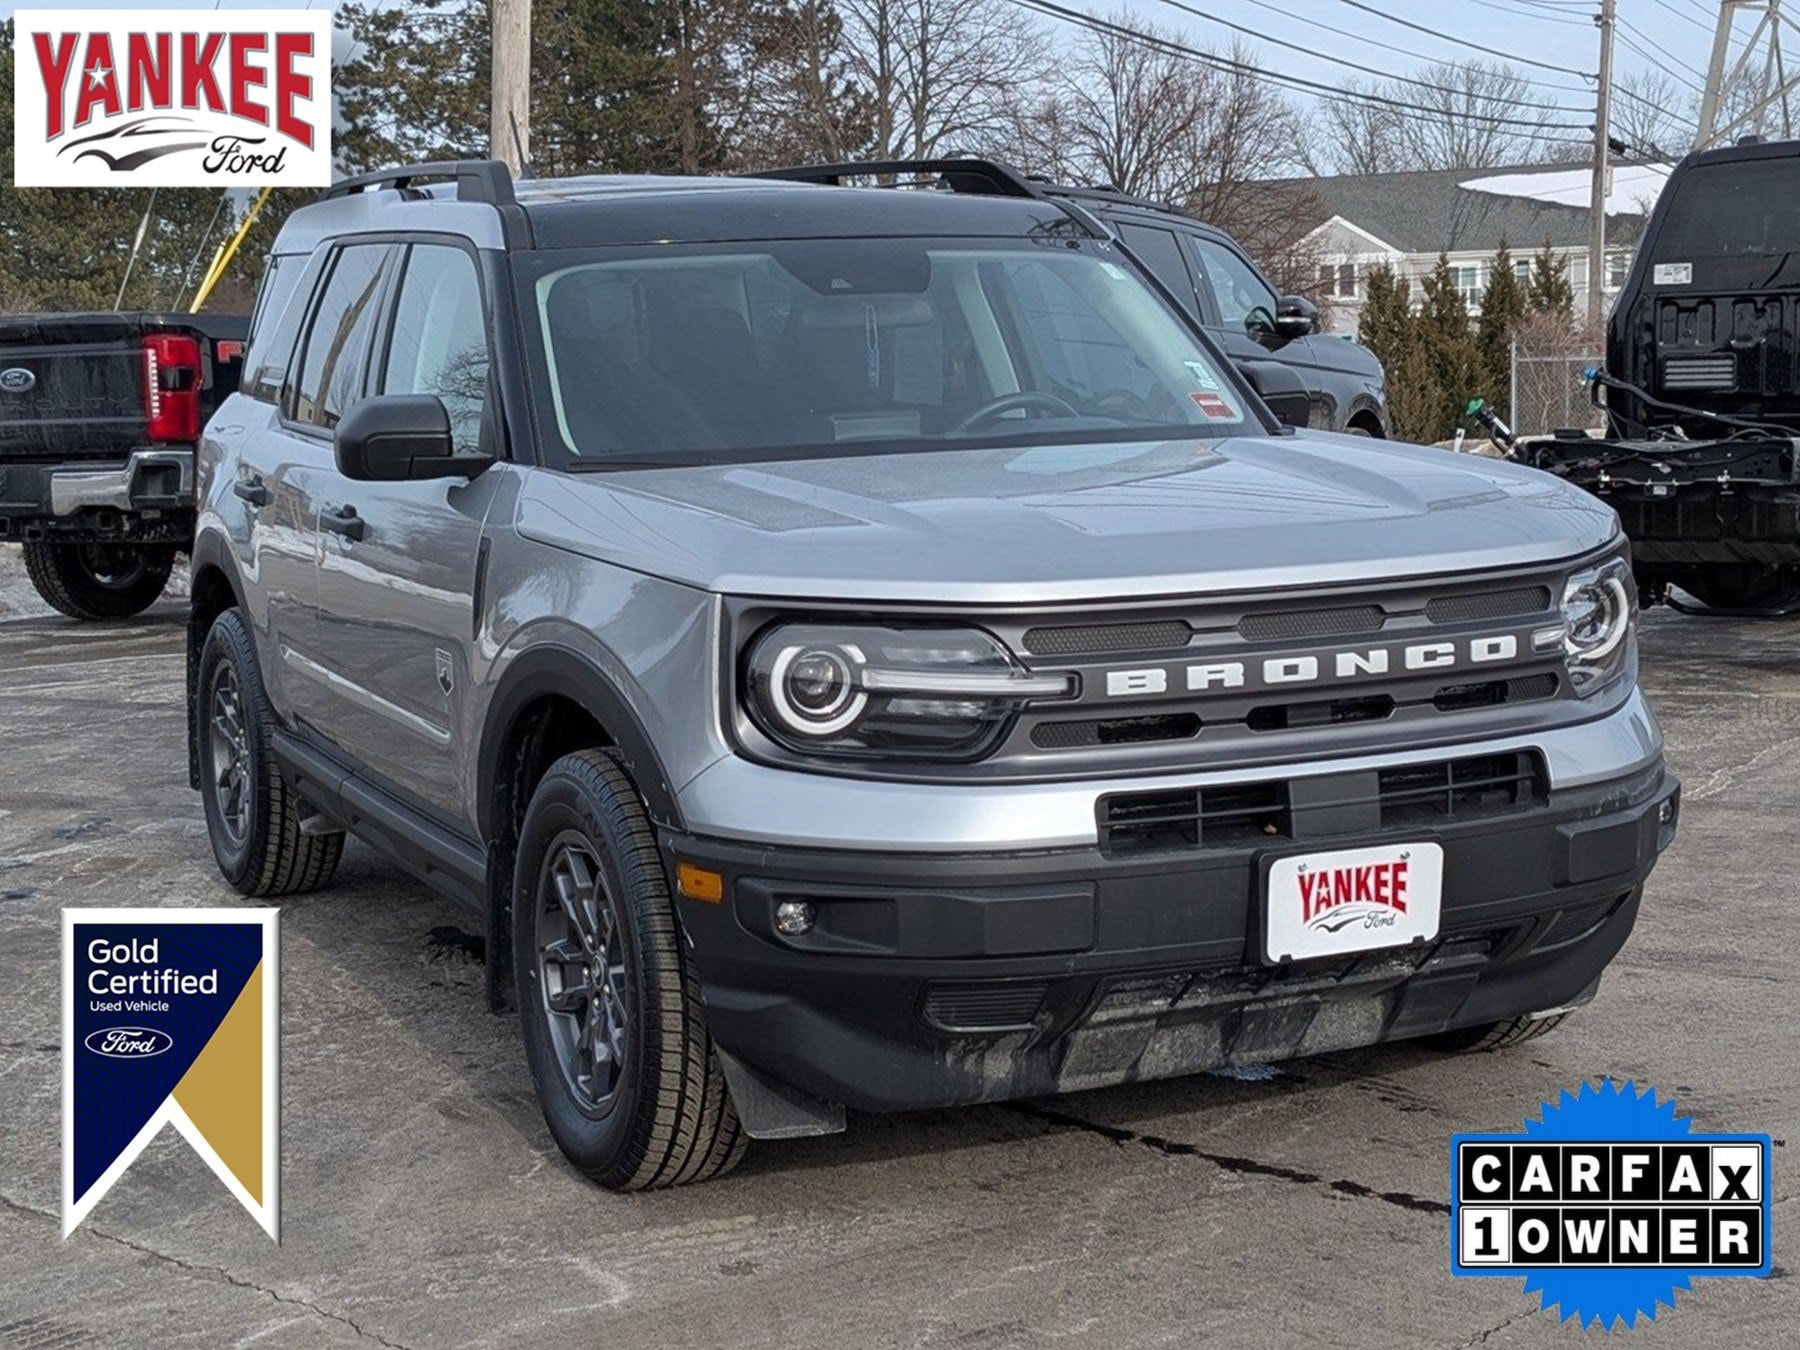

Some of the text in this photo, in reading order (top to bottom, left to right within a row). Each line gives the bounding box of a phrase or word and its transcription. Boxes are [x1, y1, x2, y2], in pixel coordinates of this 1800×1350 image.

[1106, 635, 1517, 696] BRONCO
[1297, 862, 1408, 924] YANKEE
[1364, 909, 1396, 929] Ford
